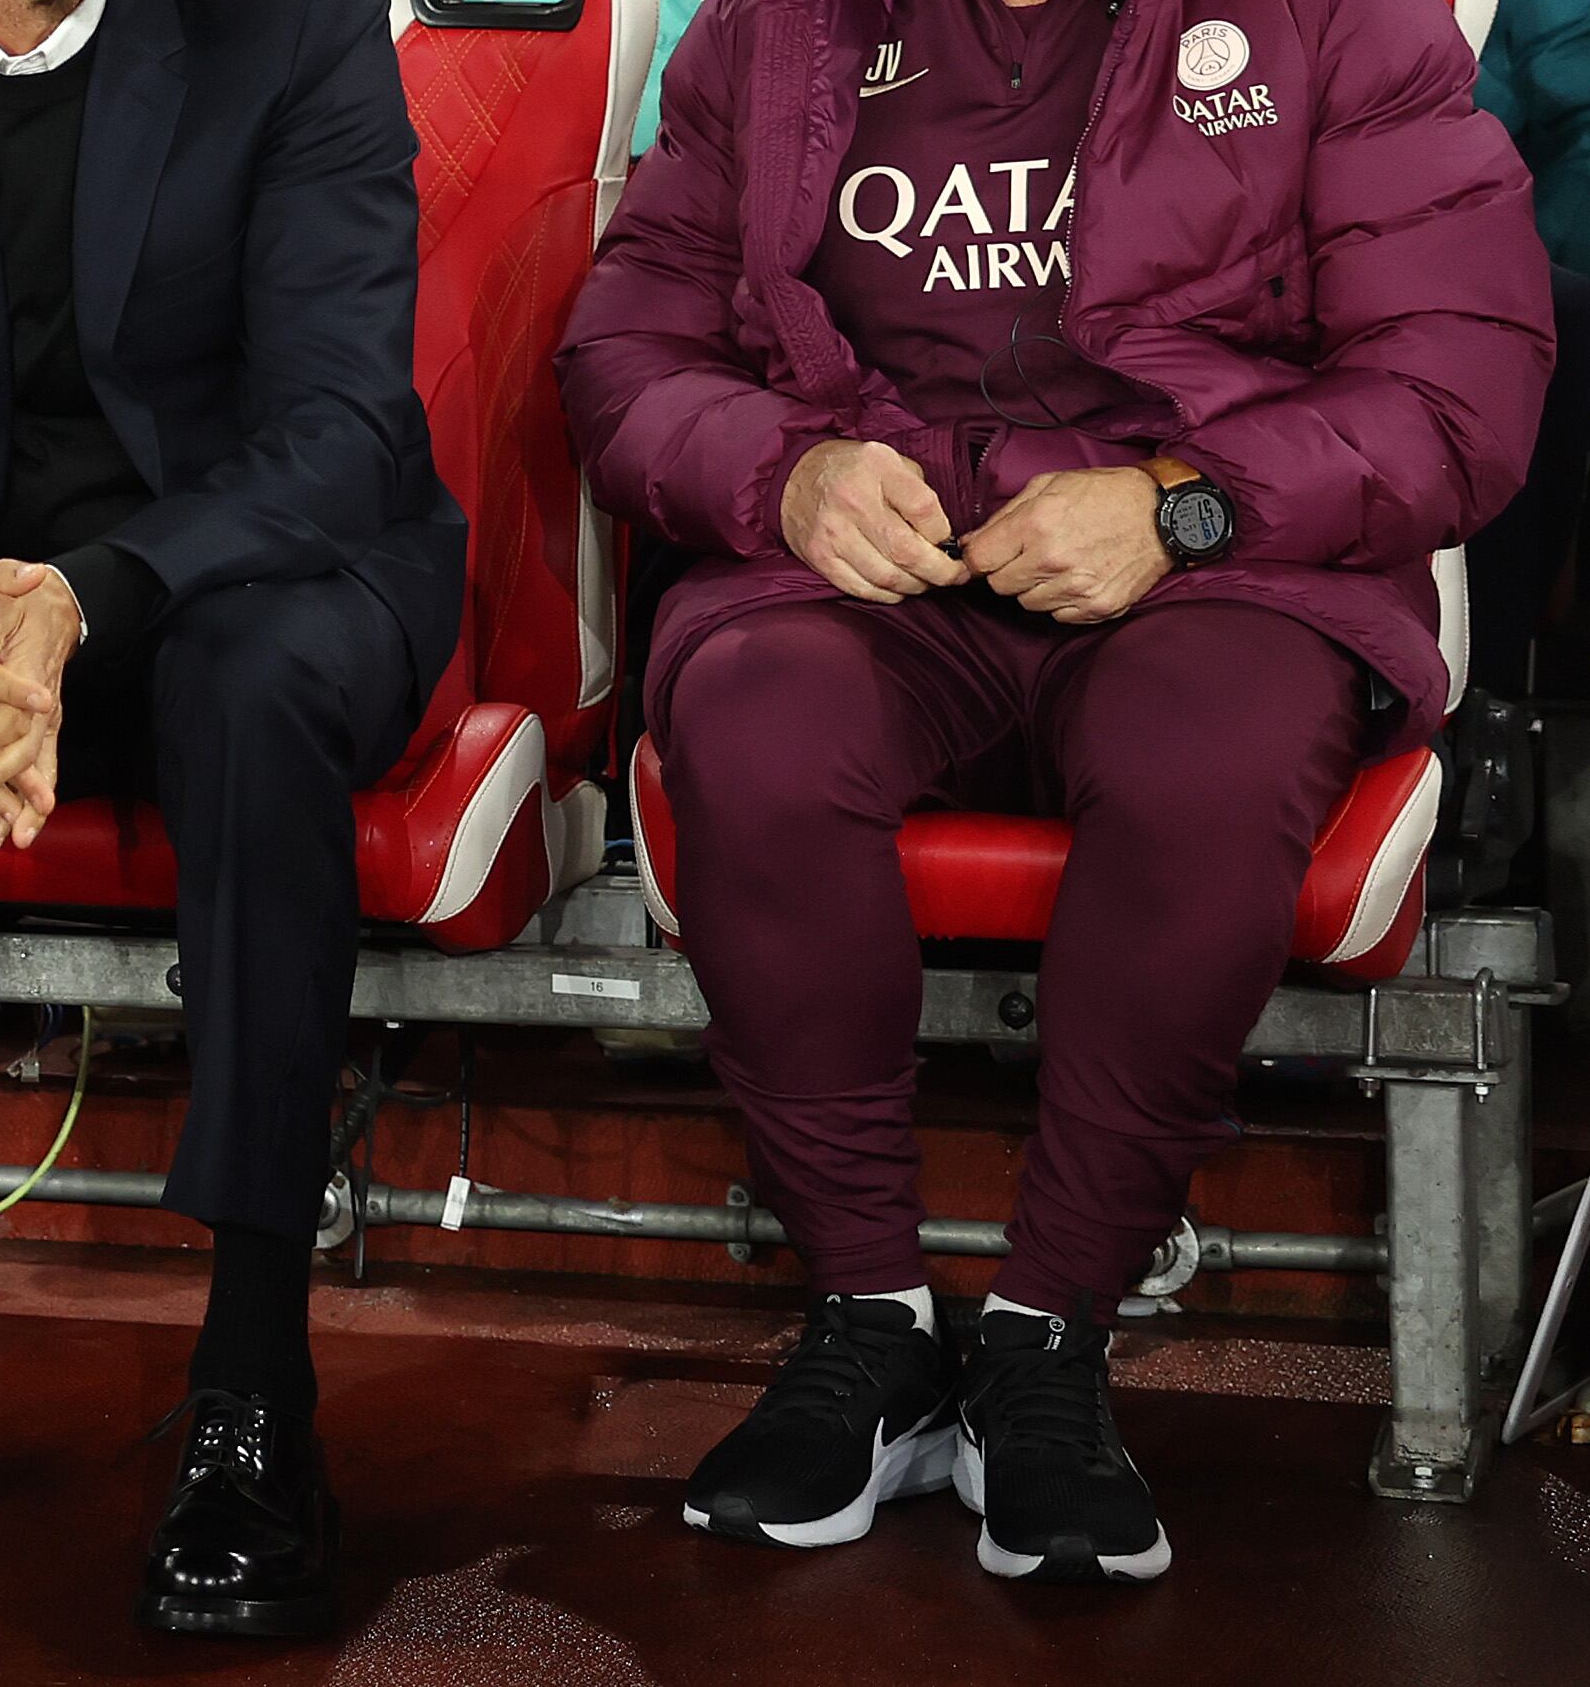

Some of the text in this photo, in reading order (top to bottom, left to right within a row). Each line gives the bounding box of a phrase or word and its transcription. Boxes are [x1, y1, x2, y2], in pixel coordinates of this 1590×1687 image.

[1181, 27, 1228, 49] PARIS
[865, 40, 902, 82] JV
[1173, 84, 1274, 123] QATAR
[839, 159, 1077, 258] QAT
[922, 240, 1073, 293] AIRW
[590, 981, 604, 993] 16
